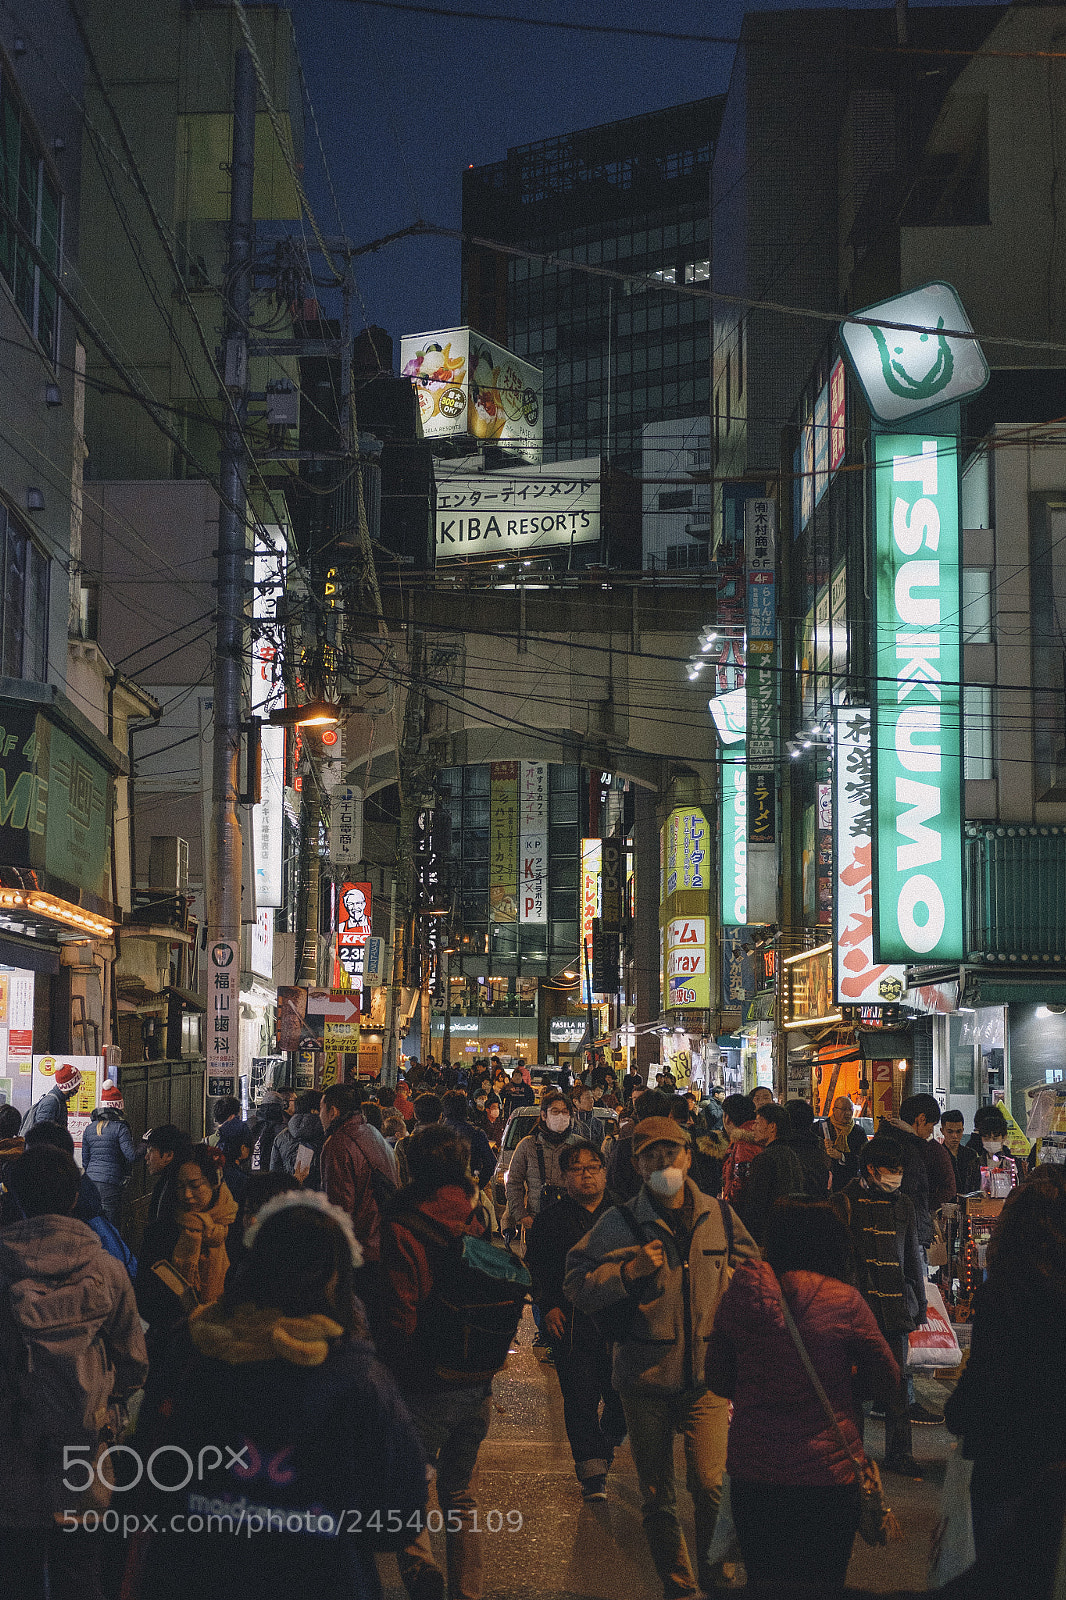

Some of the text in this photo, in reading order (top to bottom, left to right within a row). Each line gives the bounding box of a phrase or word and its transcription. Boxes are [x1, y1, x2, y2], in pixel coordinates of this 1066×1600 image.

[438, 482, 591, 509] エンターテインメント
[436, 512, 590, 544] KIBA RESORTS
[754, 573, 769, 583] 4F
[891, 441, 946, 953] TSUKUMO
[339, 802, 351, 844] 千石電商
[753, 787, 770, 833] ラーメン
[690, 815, 704, 888] トレーダー2
[214, 972, 230, 1054] 福山歯科
[876, 1065, 890, 1081] 2
